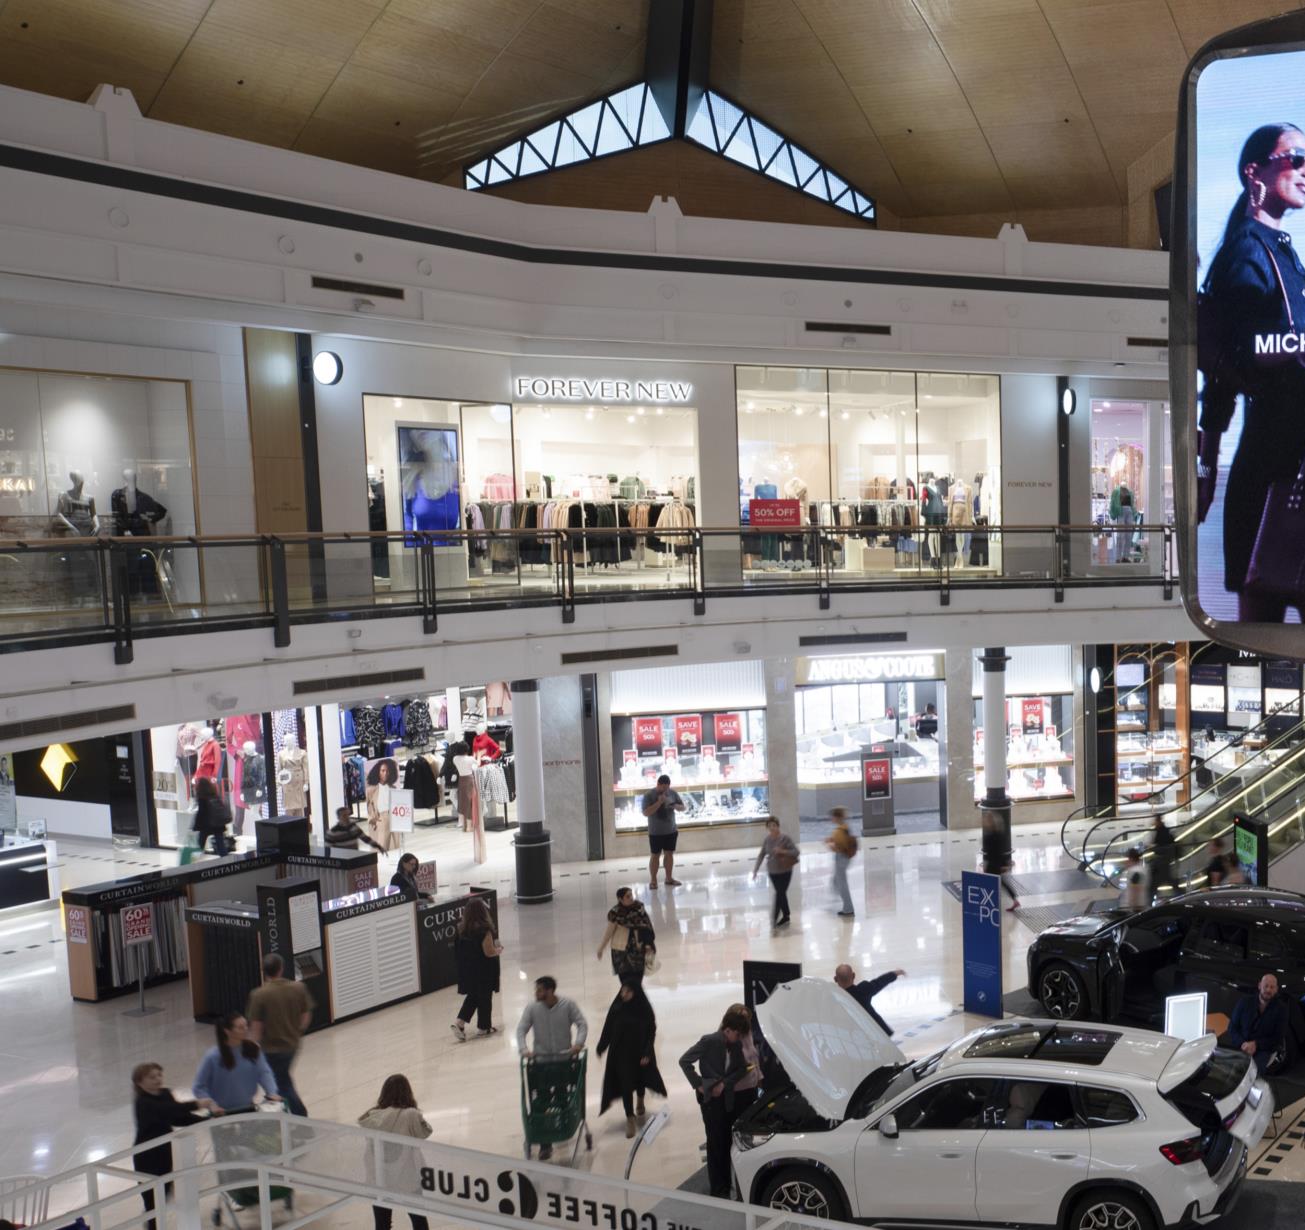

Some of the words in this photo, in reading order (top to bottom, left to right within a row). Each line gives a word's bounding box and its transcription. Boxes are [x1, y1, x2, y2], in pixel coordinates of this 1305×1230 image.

[517, 378, 630, 398] FOREVER
[638, 382, 692, 400] NEW
[754, 509, 774, 517] 50%
[808, 659, 865, 681] ANGUS
[678, 721, 698, 729] SAVE
[201, 856, 272, 878] CURTAINWORLD
[287, 855, 341, 868] CURTAINWORLD
[354, 871, 373, 882] SALE
[100, 878, 179, 901] CURTAINWORLD
[126, 907, 149, 921] 60%
[336, 894, 407, 919] CURTAINWORLD
[423, 899, 491, 929] CURTN
[192, 912, 252, 928] CURTAINWORLD
[266, 897, 280, 953] WORLD
[70, 928, 86, 938] SALE
[127, 926, 151, 939] SALE
